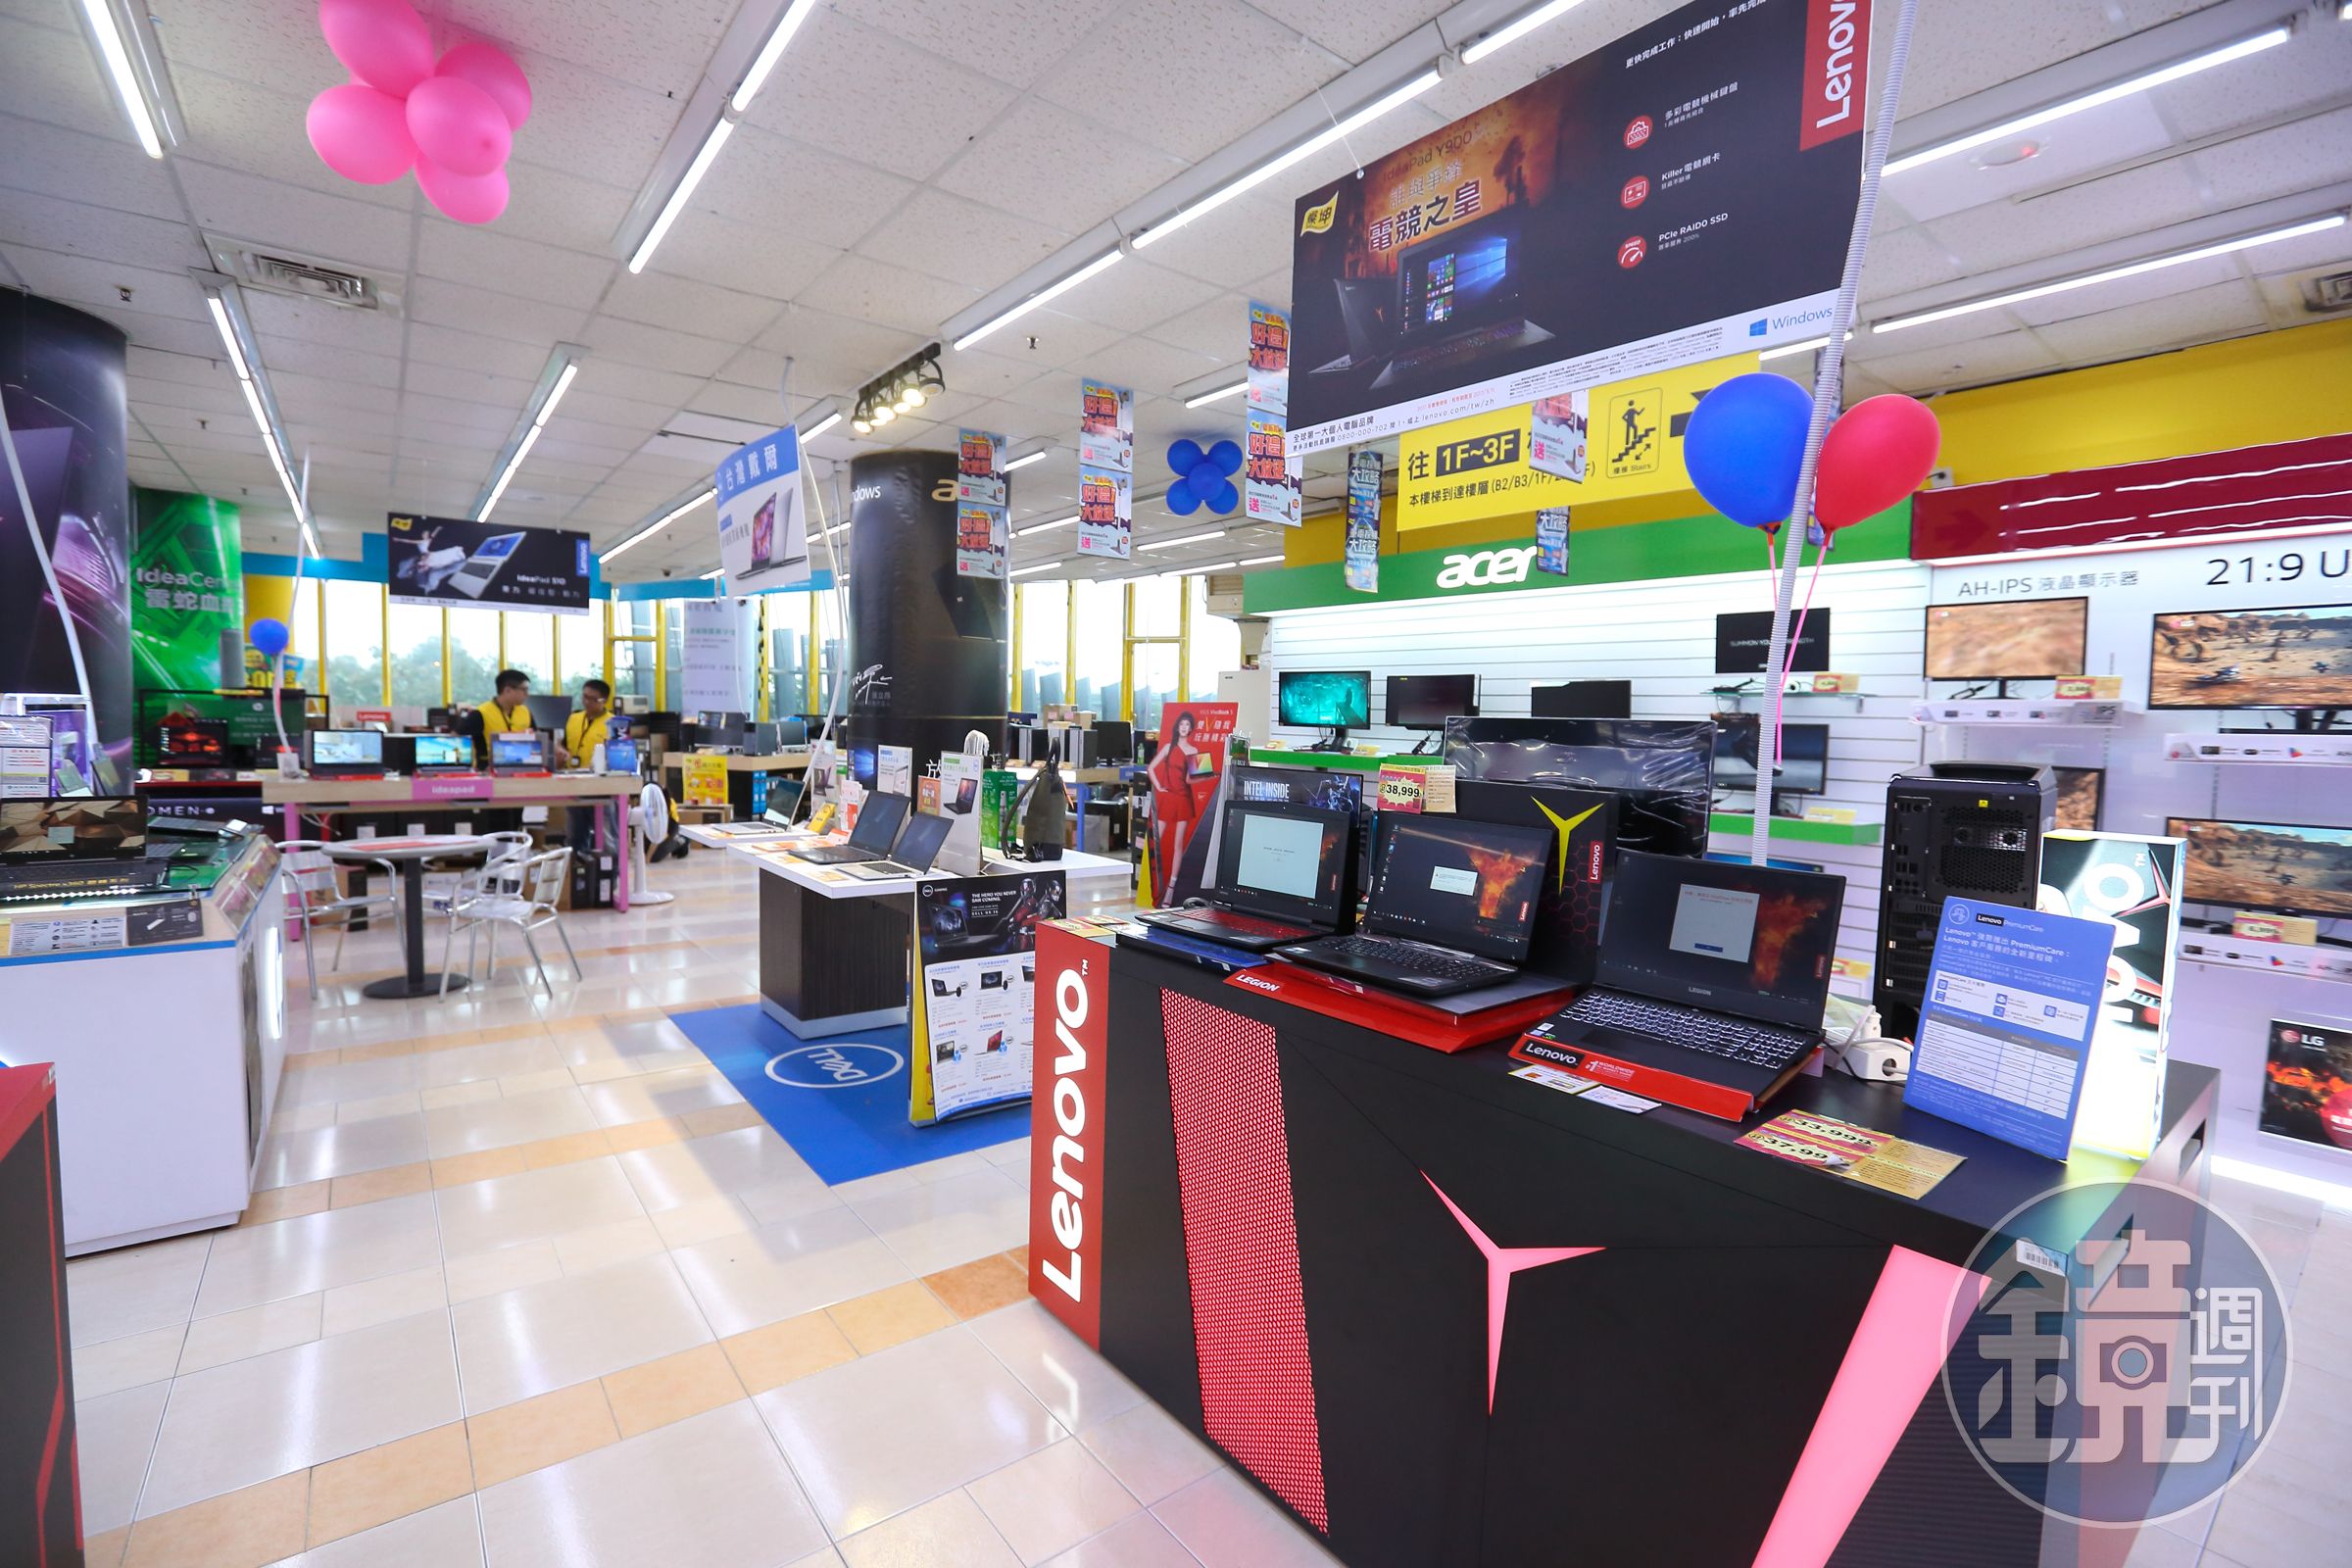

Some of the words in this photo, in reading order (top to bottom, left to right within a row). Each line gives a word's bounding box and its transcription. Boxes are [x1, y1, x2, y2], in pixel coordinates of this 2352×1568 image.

[1816, 0, 1857, 128] Lenov
[1383, 149, 1433, 181] IdeaPad
[1436, 129, 1473, 156] Y900
[1390, 160, 1463, 209] 誰與爭鋒
[1661, 168, 1684, 181] Killer
[1306, 206, 1332, 224] 燦坤
[1368, 179, 1483, 253] 電競之皇
[1658, 230, 1679, 242] PCIe
[1709, 213, 1729, 225] SSD
[1772, 306, 1833, 330] Windows
[1337, 424, 1388, 442] 0800-000-702
[1421, 397, 1495, 421] lenovo.com/tw/zh
[725, 444, 777, 490] 台灣戴爾
[1407, 451, 1430, 481] 往
[1442, 433, 1515, 471] 1F~3F
[1631, 463, 1651, 471] Stairs
[1409, 479, 1490, 508] 本樓梯到達樓層
[579, 543, 588, 574] Lenovo
[1436, 545, 1537, 588] acer
[2206, 553, 2304, 586] 21:9
[1958, 577, 2033, 597] AH-IPS
[2037, 570, 2139, 592] 液晶顯示器
[432, 786, 475, 796] ideapad
[1245, 780, 1263, 797] INTEL
[1265, 781, 1290, 799] INSIDE
[1386, 784, 1420, 798] 38,999
[1591, 844, 1601, 881] Lenovo
[1978, 914, 2002, 925] Lenovo
[1943, 935, 1970, 946] Lenovo
[1235, 973, 1280, 992] LEGION
[1688, 986, 1712, 997] LEGION
[1525, 1043, 1576, 1064] Lenovo
[2301, 1034, 2325, 1047] LG
[808, 1048, 868, 1082] DELL
[1042, 967, 1089, 1302] Lenovo
